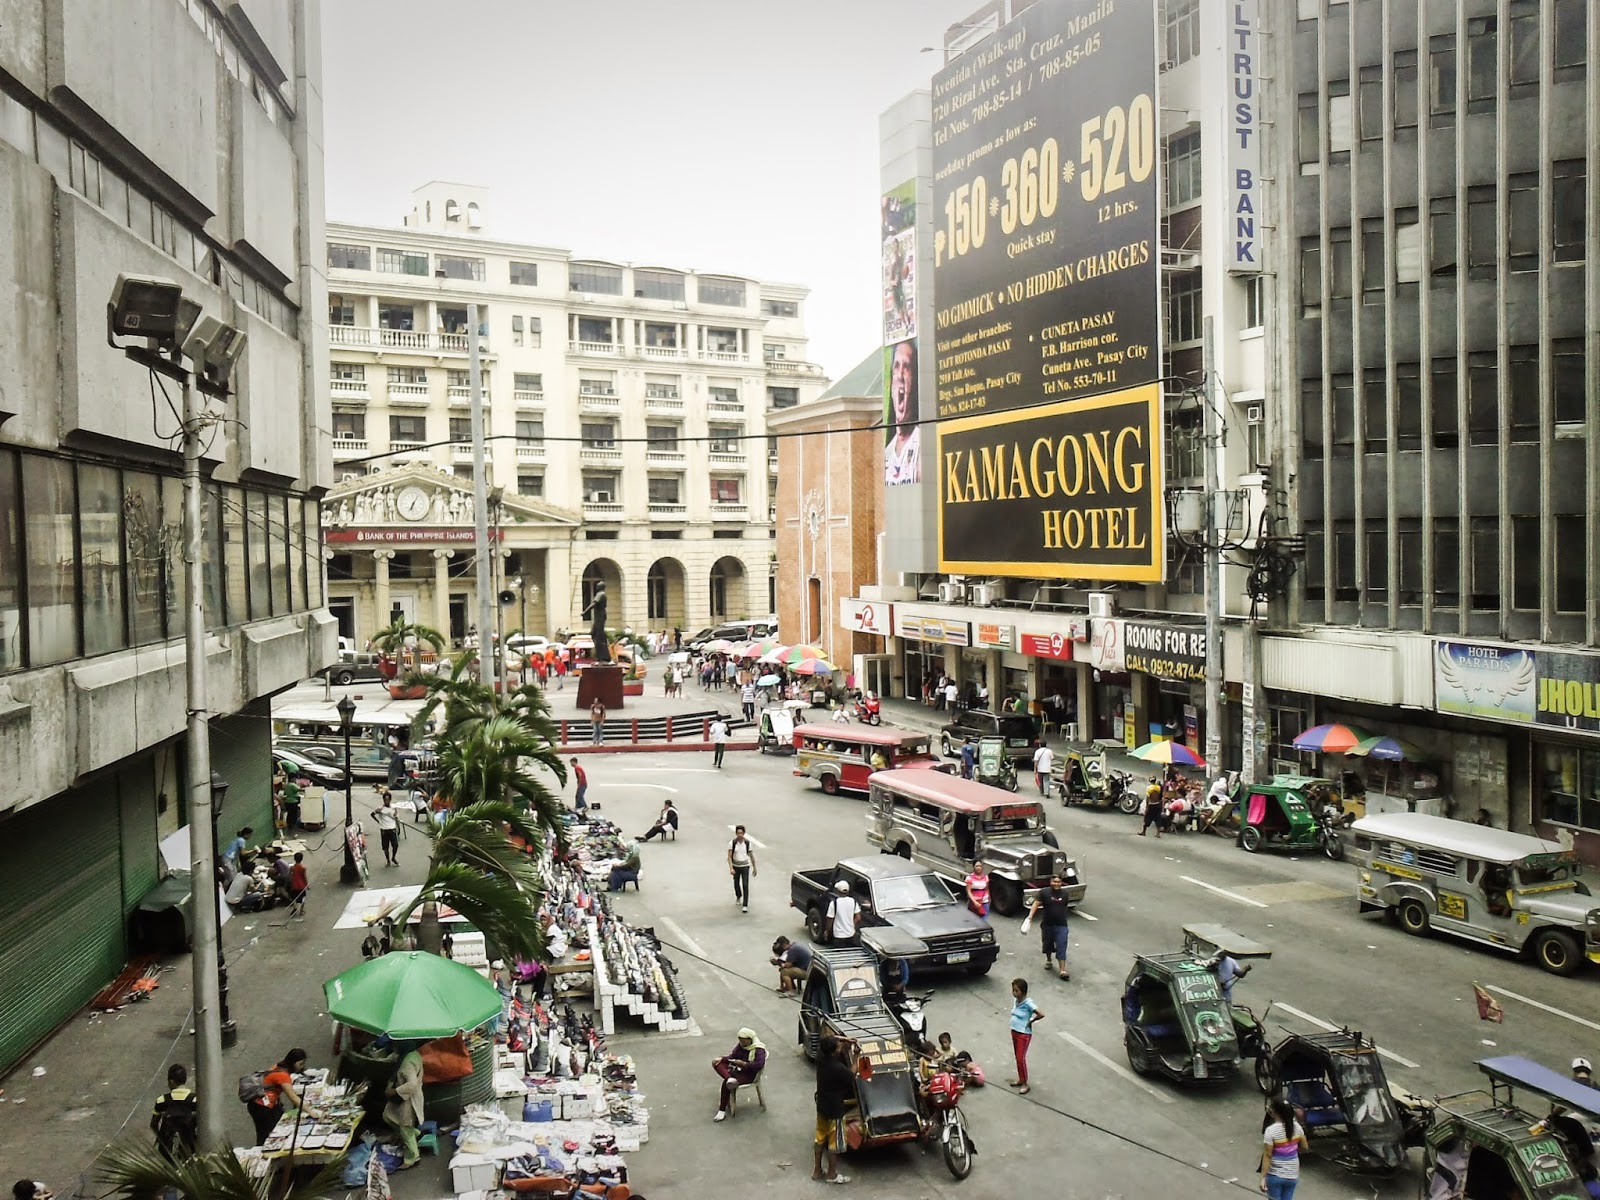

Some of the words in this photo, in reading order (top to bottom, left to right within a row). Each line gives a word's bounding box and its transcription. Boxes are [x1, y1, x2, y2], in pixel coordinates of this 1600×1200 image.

[933, 106, 949, 124] 720
[951, 84, 976, 112] Rizal
[977, 74, 1000, 96] Ave.
[1006, 58, 1026, 78] Sta.
[1067, 0, 1114, 40] Manila
[933, 68, 971, 99] Avenida
[973, 27, 1026, 76] (Walk-up)
[1234, 0, 1252, 149] LTRUST
[933, 127, 947, 147] Tel
[949, 119, 969, 139] Nos.
[971, 80, 1022, 125] 708-85-14
[1039, 32, 1101, 83] 708-85-05
[935, 156, 966, 181] weekday
[966, 142, 993, 167] promo
[995, 134, 1004, 149] as
[1005, 125, 1021, 142] low
[1022, 116, 1037, 132] as:
[1001, 137, 1058, 235] 360
[1080, 93, 1154, 202] 520
[1097, 205, 1111, 223] 12
[1115, 199, 1139, 217] hrs.
[1236, 169, 1254, 263] BANK
[1007, 235, 1034, 259] Quick
[1036, 228, 1056, 244] stay
[937, 309, 949, 330] NO
[950, 291, 995, 325] GIMMICK
[1007, 281, 1024, 305] NO
[1026, 263, 1074, 299] HIDDEN
[1076, 240, 1149, 282] CHARGES
[126, 316, 138, 327] 40
[1041, 320, 1080, 340] CUNETA
[1082, 310, 1115, 330] PASAY
[938, 342, 950, 352] Visit
[951, 339, 961, 348] our
[962, 332, 978, 345] other
[979, 322, 1012, 339] branches:
[1042, 344, 1058, 358] F.B.
[1060, 336, 1098, 354] Harrison
[1101, 332, 1118, 344] cor.
[939, 356, 954, 370] TAFT
[954, 346, 987, 365] ROTONDA
[987, 338, 1012, 355] PASAY
[1042, 361, 1072, 376] Cuneta
[1073, 358, 1092, 370] Ave.
[1097, 351, 1124, 365] Pasay
[1127, 344, 1149, 359] City
[952, 369, 962, 381] Taft
[964, 368, 975, 377] Ave.
[986, 377, 1005, 388] Pasay
[1006, 372, 1021, 385] City
[1043, 381, 1055, 394] Tel
[1057, 379, 1071, 391] No.
[1073, 369, 1117, 388] 553-70-11
[945, 425, 1145, 504] KAMAGONG
[365, 532, 384, 540] BANK
[386, 532, 395, 540] OF
[396, 532, 409, 540] THE
[1041, 507, 1146, 550] HOTEL
[1126, 625, 1161, 651] ROOMS
[1165, 630, 1187, 655] FOR
[1468, 647, 1500, 659] HOTEL
[1126, 654, 1149, 673] CALL
[1459, 656, 1511, 672] PARADIS
